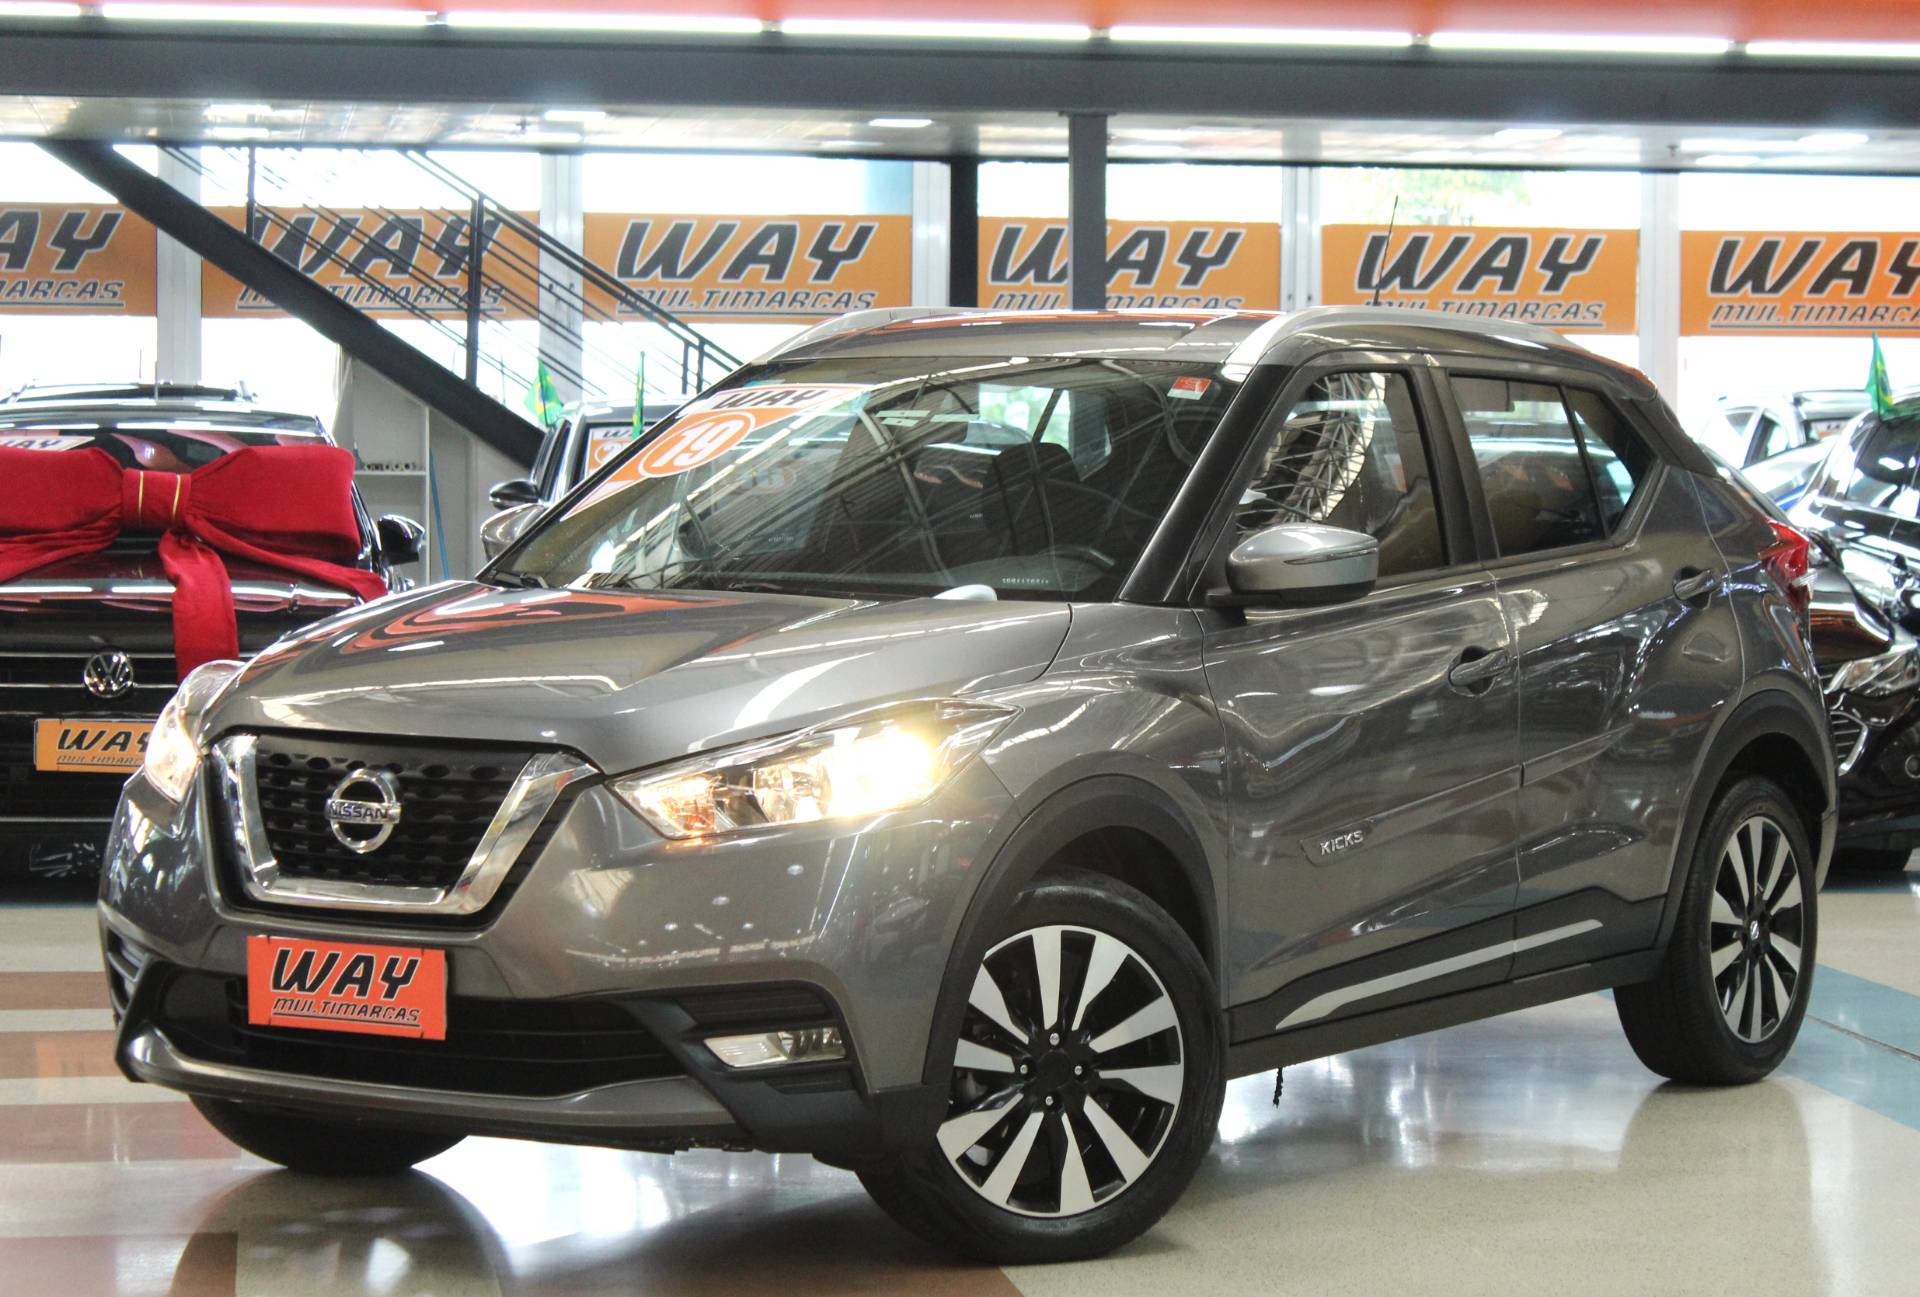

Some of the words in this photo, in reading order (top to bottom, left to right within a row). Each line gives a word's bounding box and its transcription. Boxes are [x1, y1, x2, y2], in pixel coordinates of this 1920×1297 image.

[615, 219, 879, 283] WAY
[988, 224, 1248, 289] WAY
[1354, 232, 1606, 295] WAY
[0, 279, 125, 299] ARCAS
[711, 390, 829, 409] WAY
[652, 418, 746, 469] 19
[328, 802, 388, 818] NISSAN
[1320, 830, 1364, 856] KICKS
[271, 948, 421, 1001] WAY
[272, 998, 420, 1023] MULTIMARCAS
